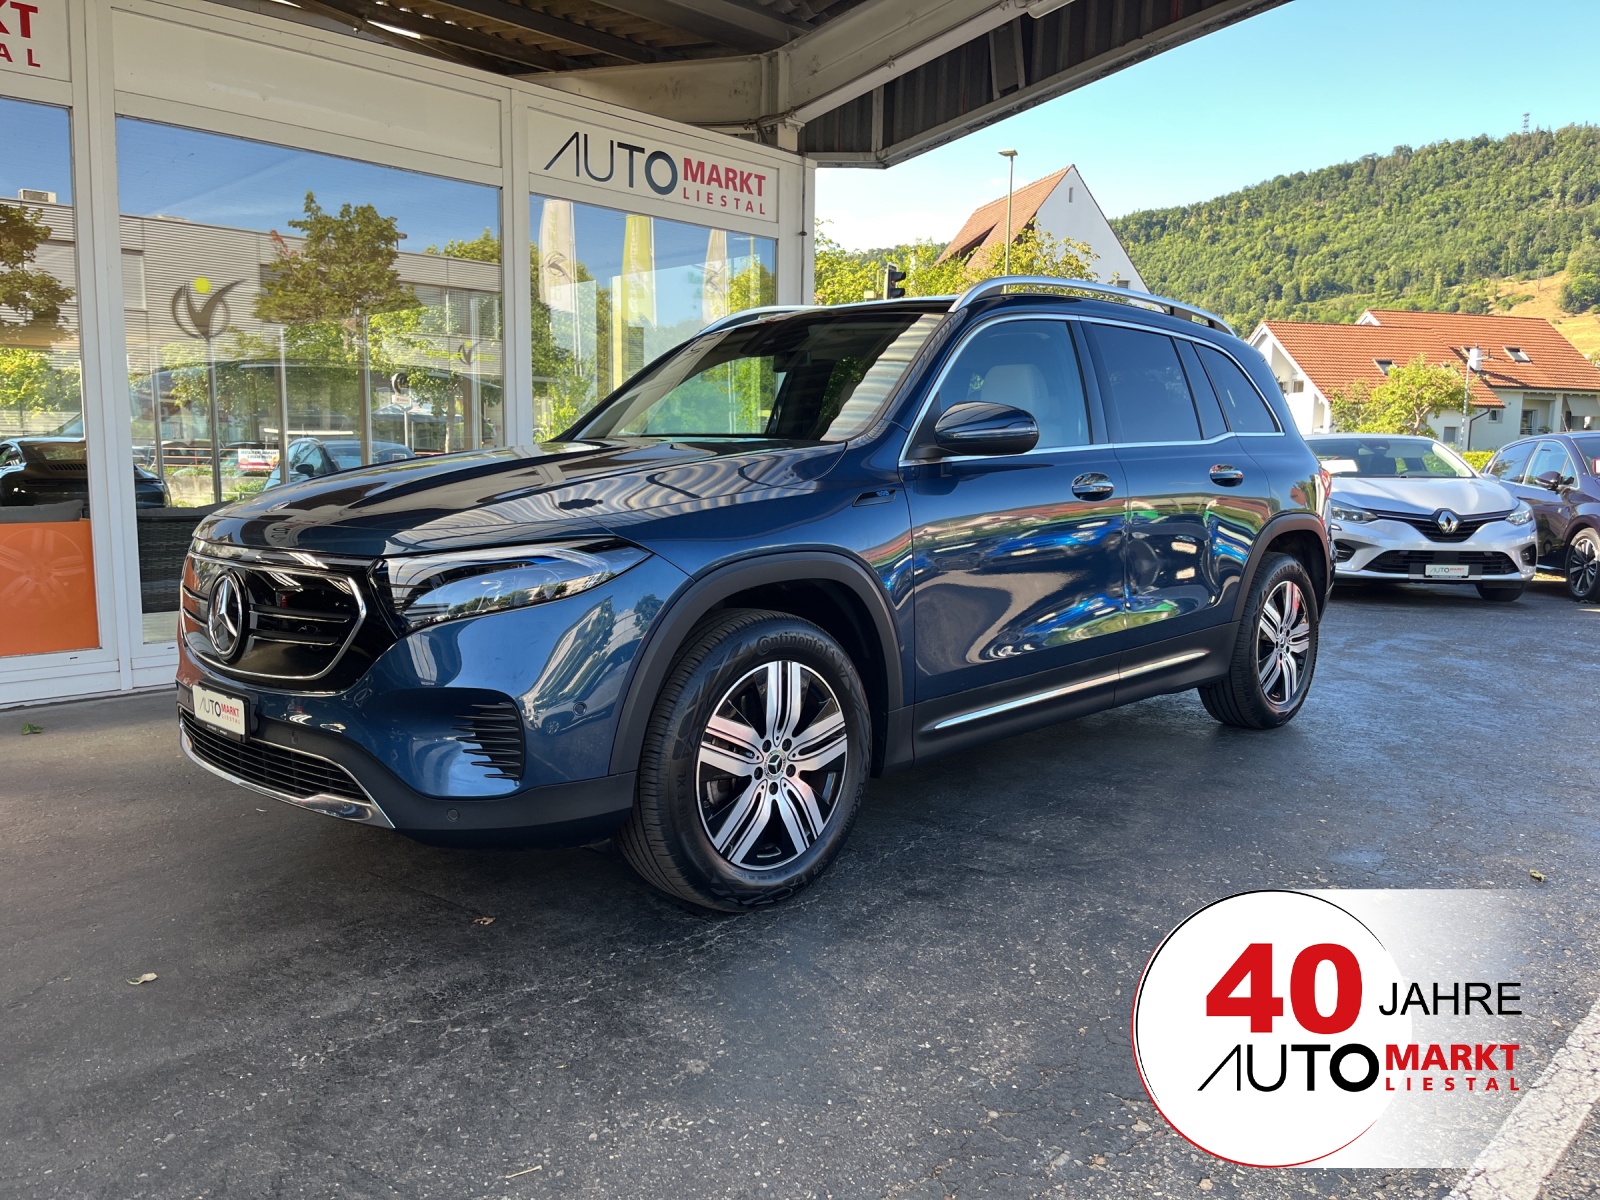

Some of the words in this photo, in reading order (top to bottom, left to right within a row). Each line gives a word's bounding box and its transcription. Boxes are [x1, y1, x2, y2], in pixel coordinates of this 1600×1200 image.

[543, 131, 678, 195] AUTO
[683, 157, 766, 197] MARKT
[683, 186, 766, 215] LIESTAL
[756, 629, 829, 656] Continental
[199, 697, 221, 717] AUTO
[221, 703, 240, 718] MARKT
